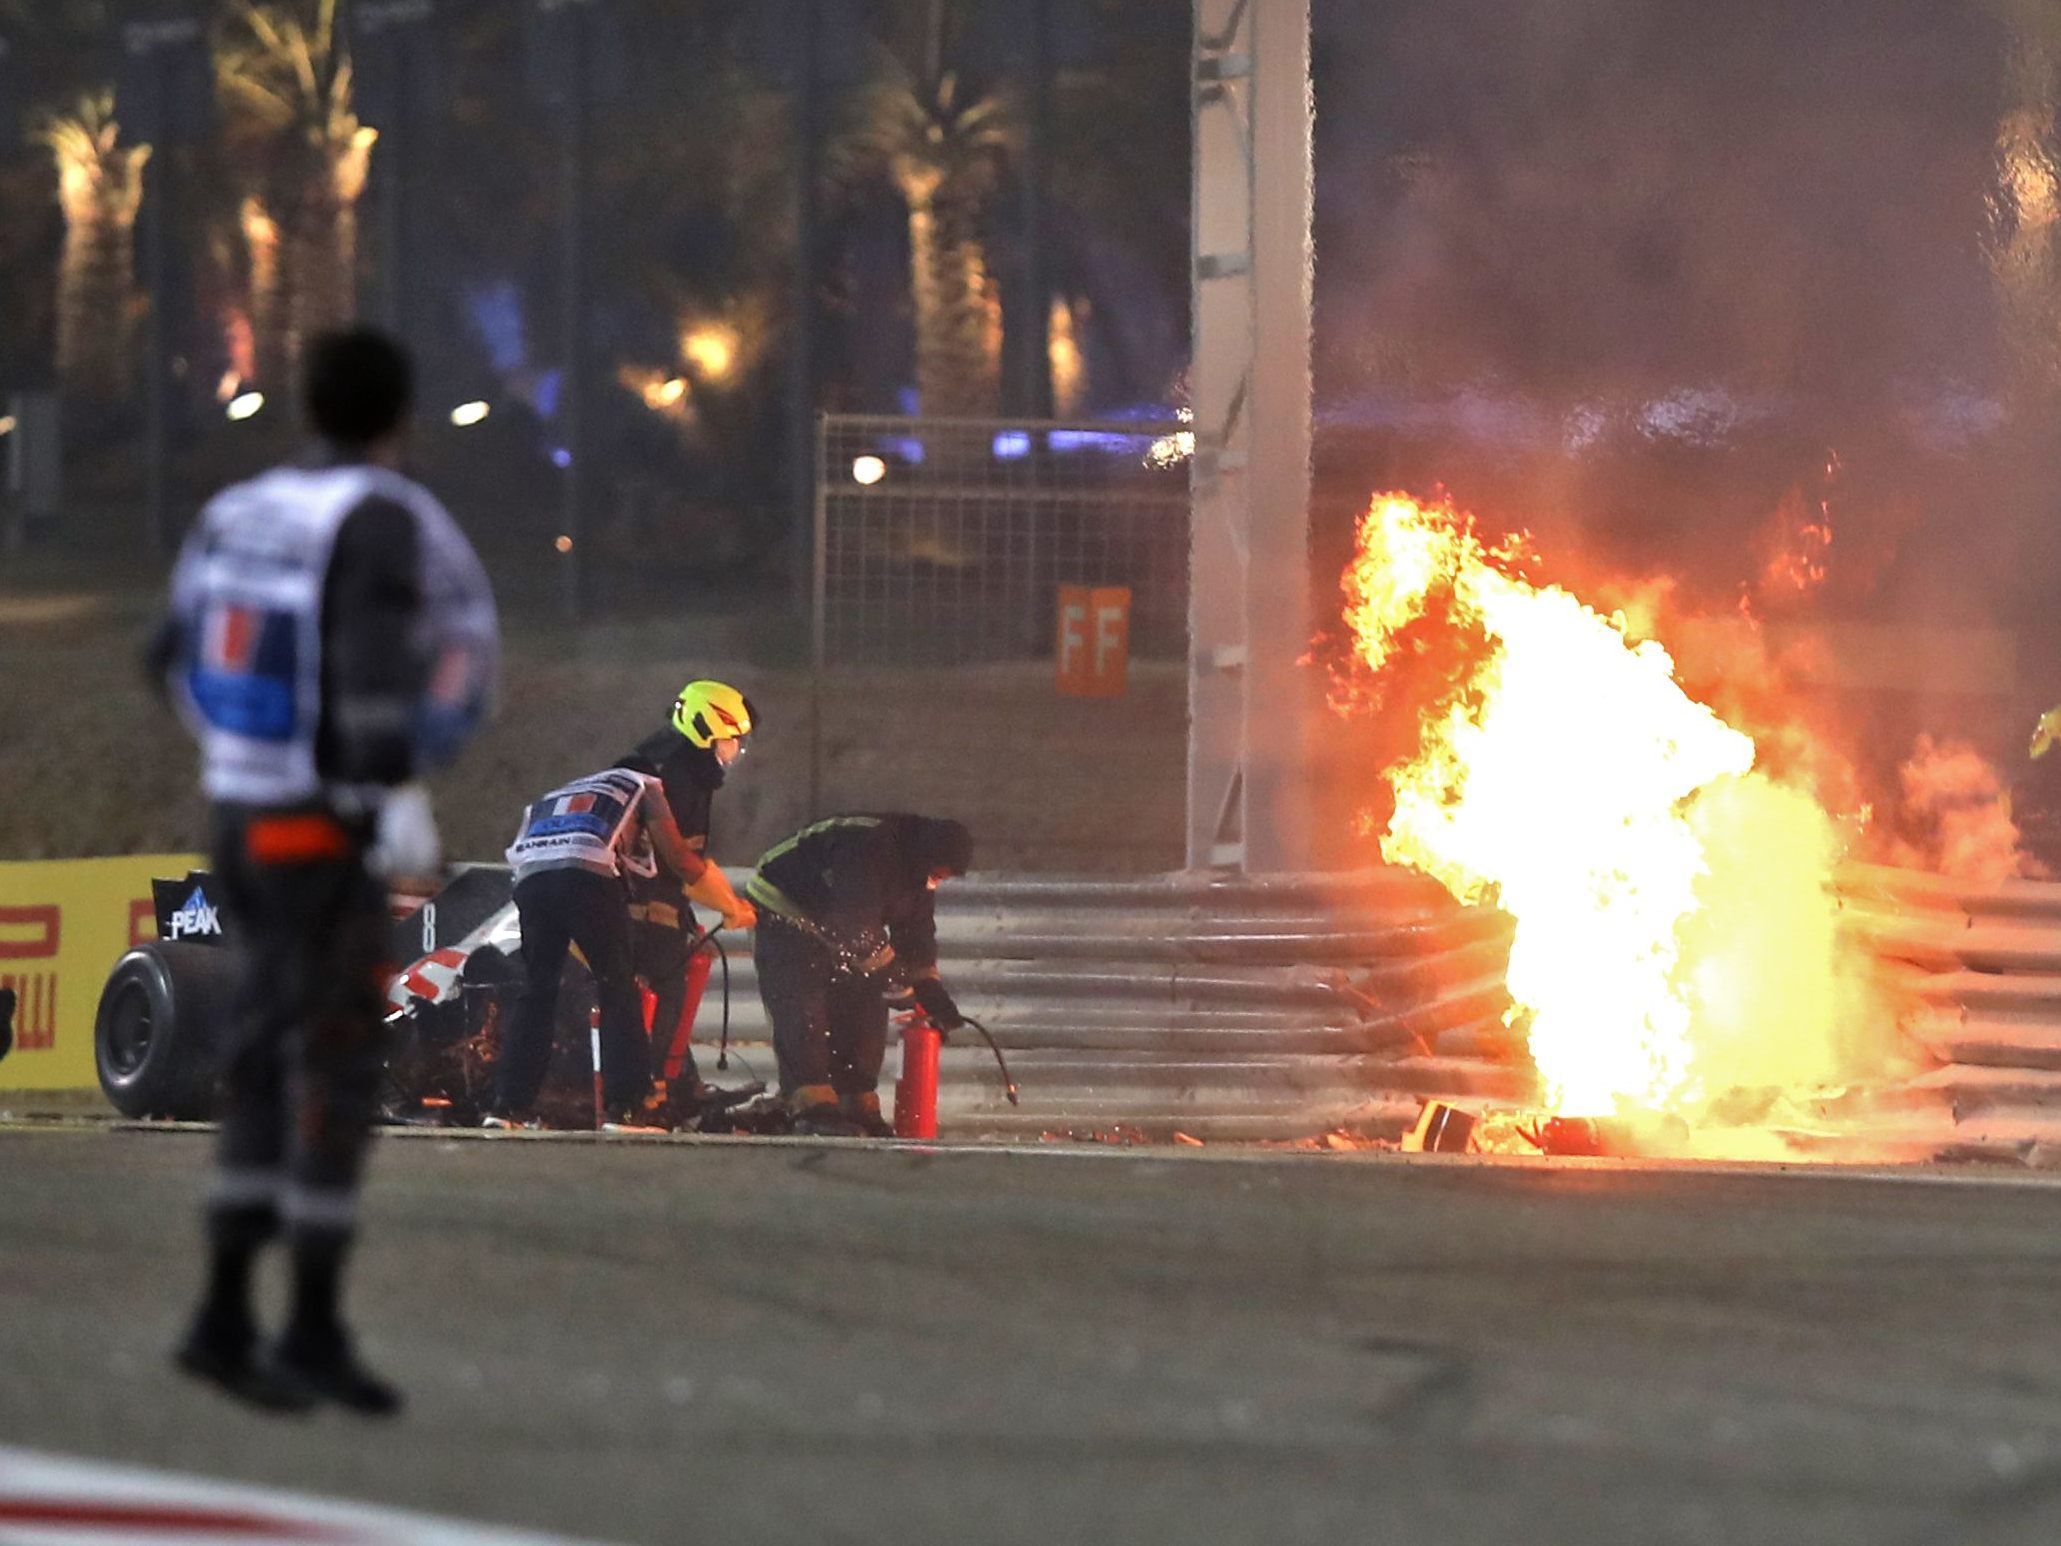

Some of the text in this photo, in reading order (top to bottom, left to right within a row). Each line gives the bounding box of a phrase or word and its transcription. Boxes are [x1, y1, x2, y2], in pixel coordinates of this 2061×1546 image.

[516, 837, 571, 853] BAHRAIN
[171, 907, 222, 940] PEAK
[422, 902, 436, 953] 8
